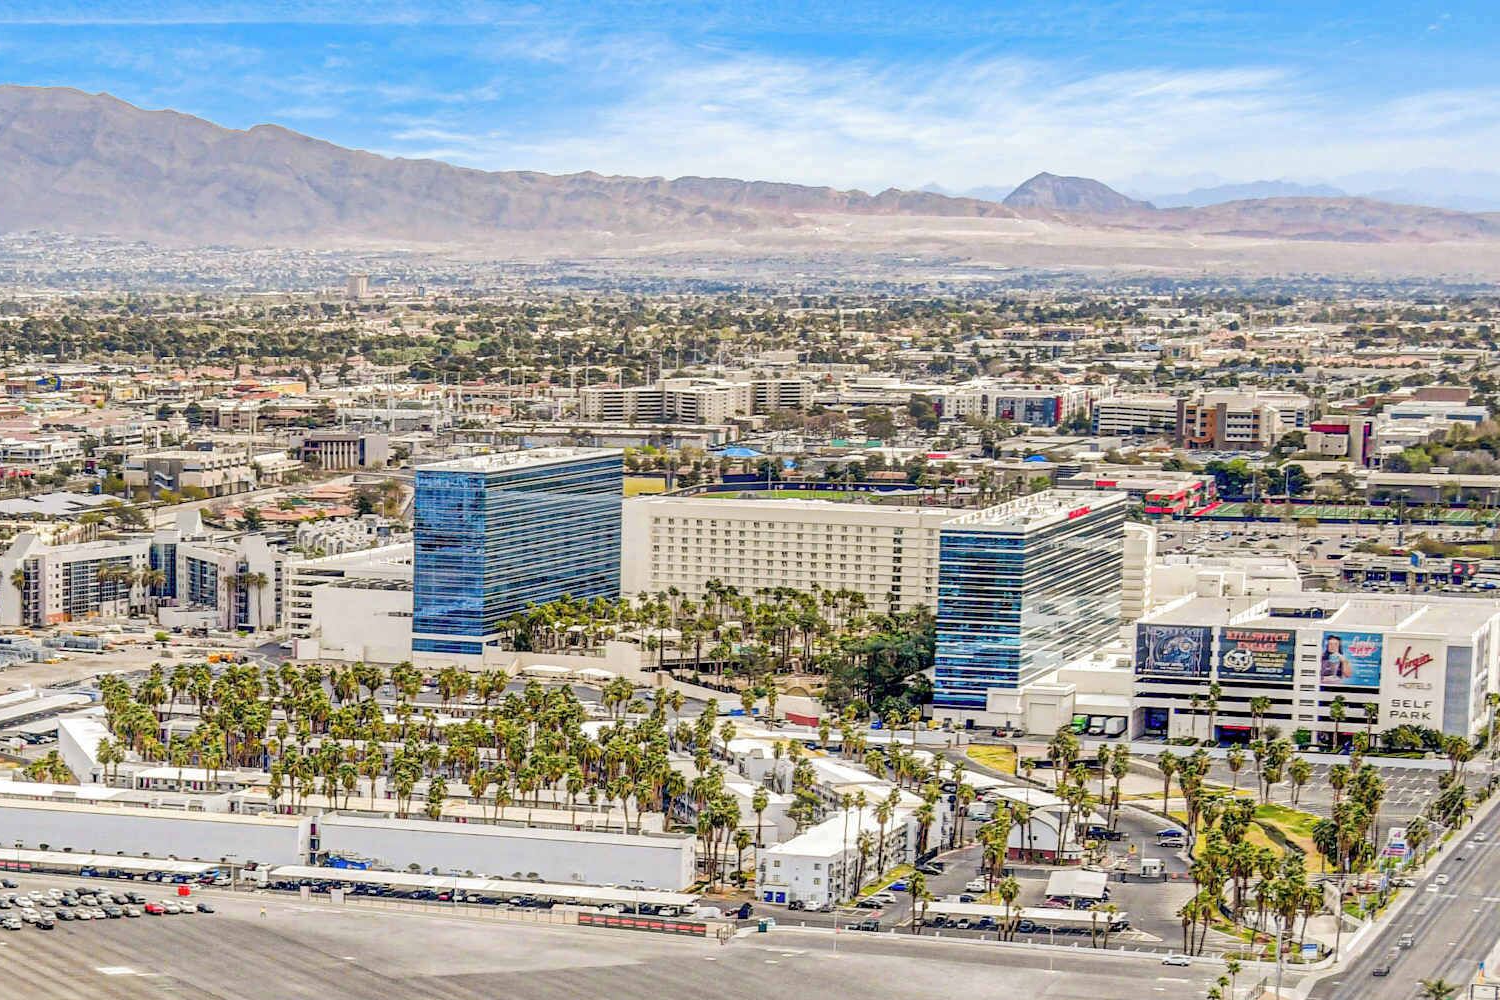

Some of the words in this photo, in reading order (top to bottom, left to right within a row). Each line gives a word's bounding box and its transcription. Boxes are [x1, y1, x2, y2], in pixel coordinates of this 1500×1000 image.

[1394, 645, 1433, 679] Virgin
[1397, 682, 1433, 690] HOTELS
[1390, 699, 1433, 708] SELF
[1389, 710, 1432, 720] PARK
